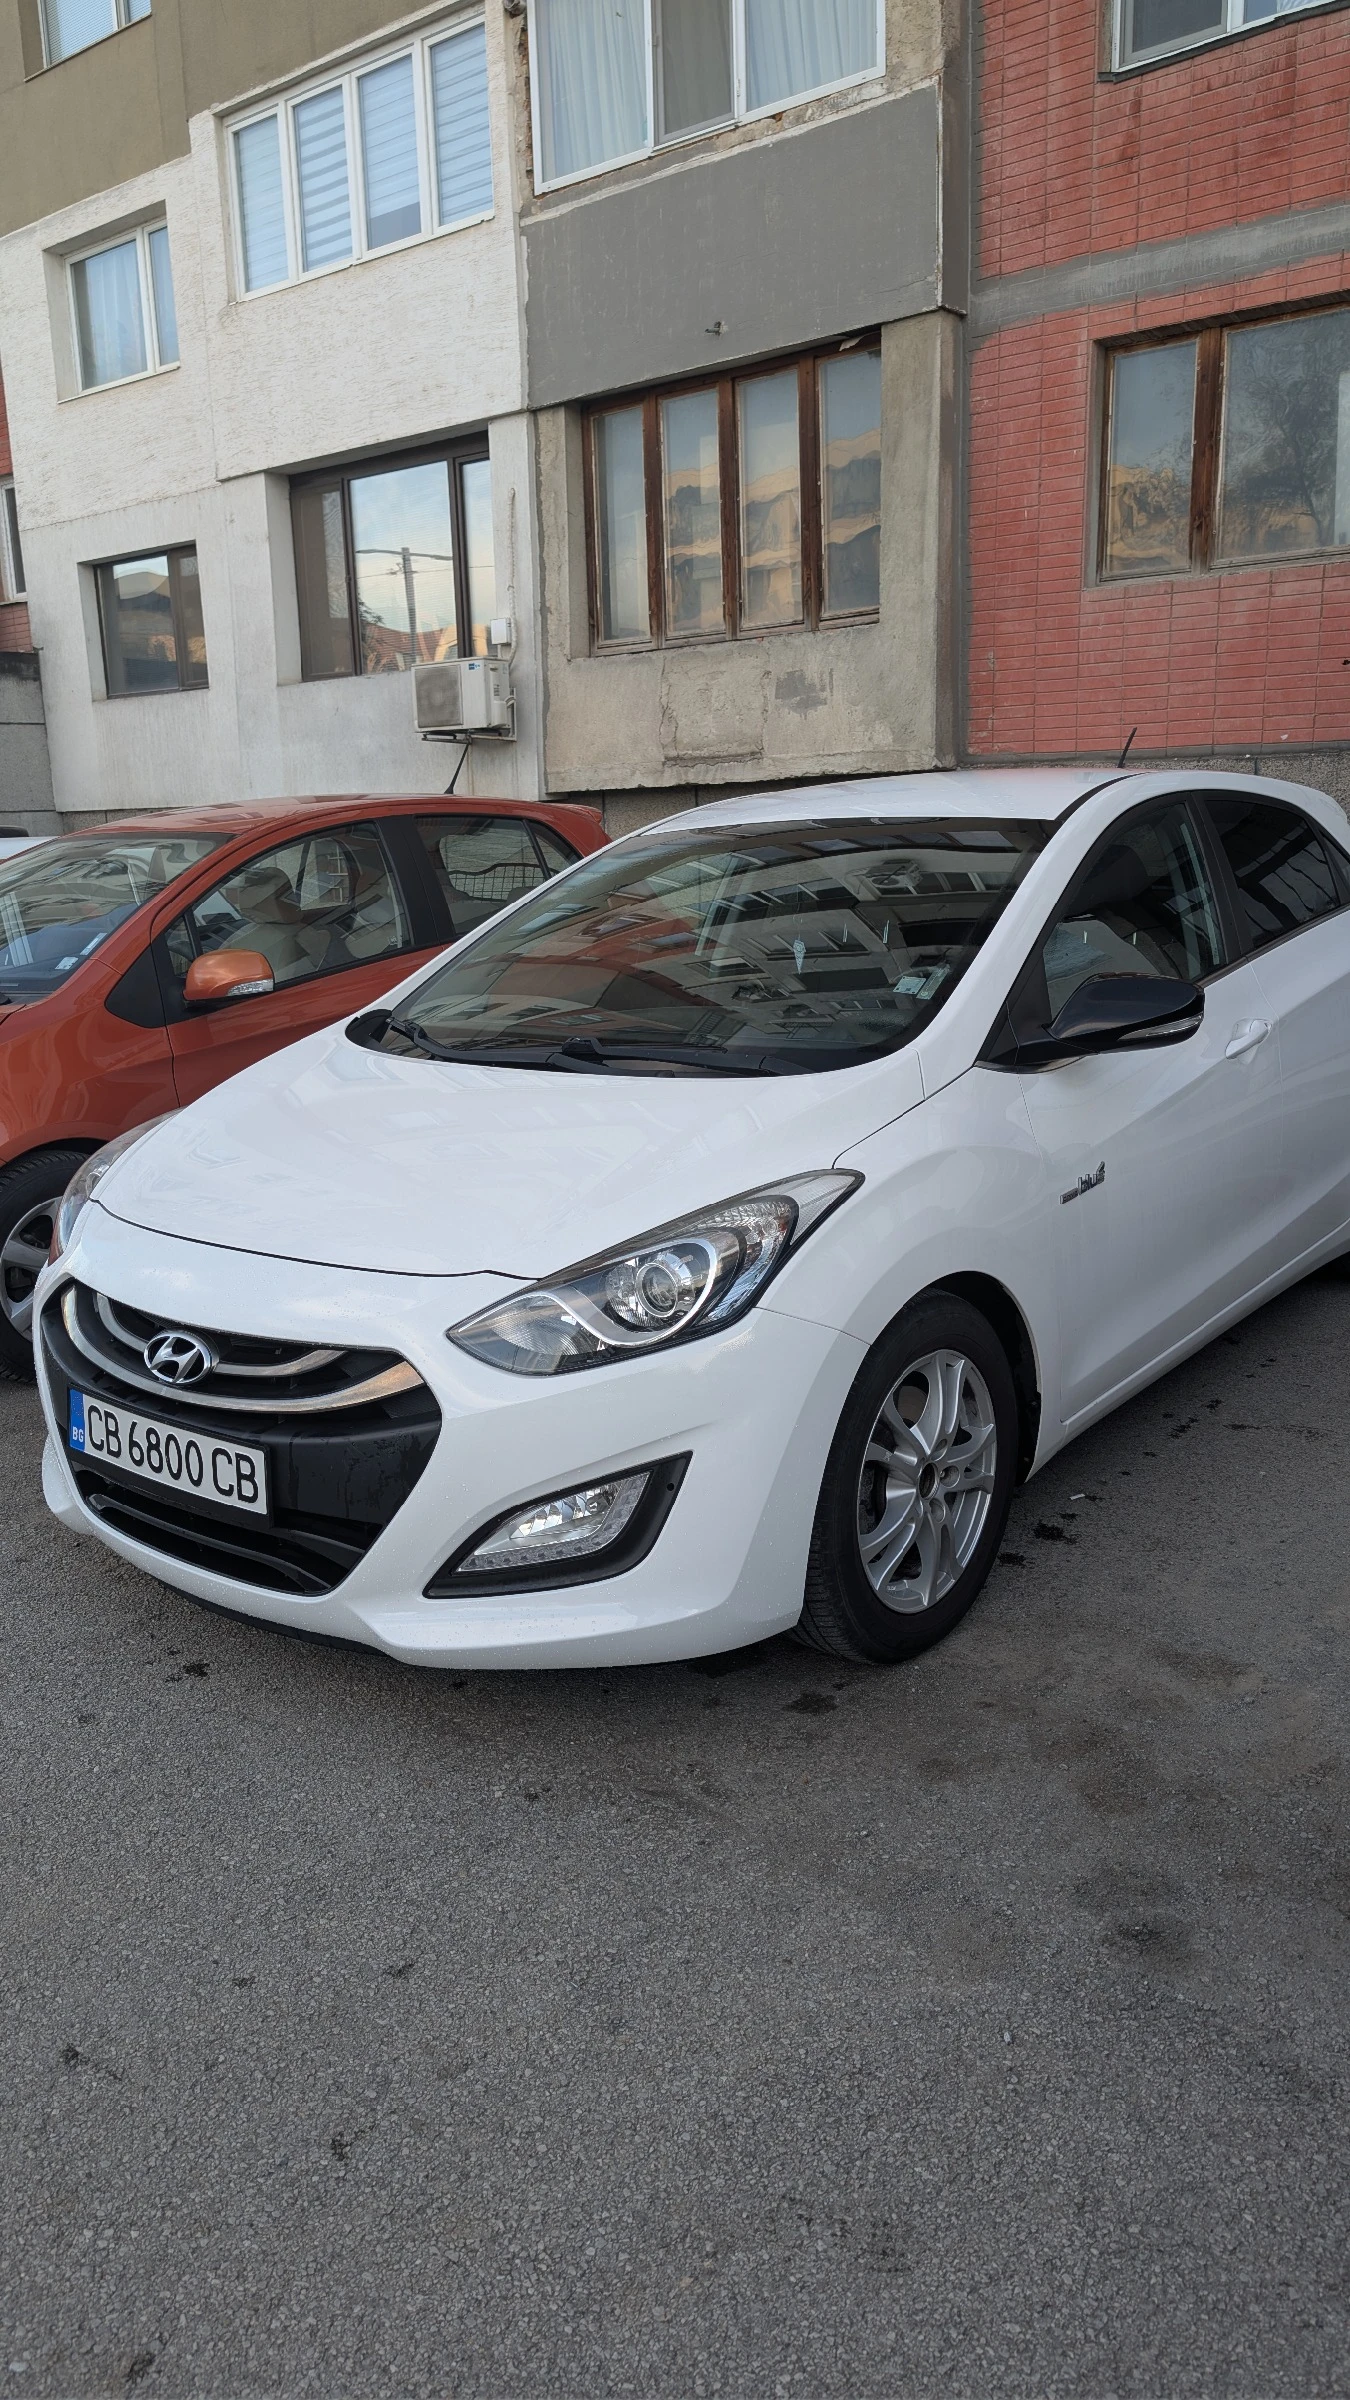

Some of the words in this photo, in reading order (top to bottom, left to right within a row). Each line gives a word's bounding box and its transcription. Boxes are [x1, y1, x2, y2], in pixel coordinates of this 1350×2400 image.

[72, 1425, 84, 1443] BG
[87, 1404, 122, 1459] CB
[128, 1420, 204, 1487] 6800
[211, 1447, 259, 1504] CB
